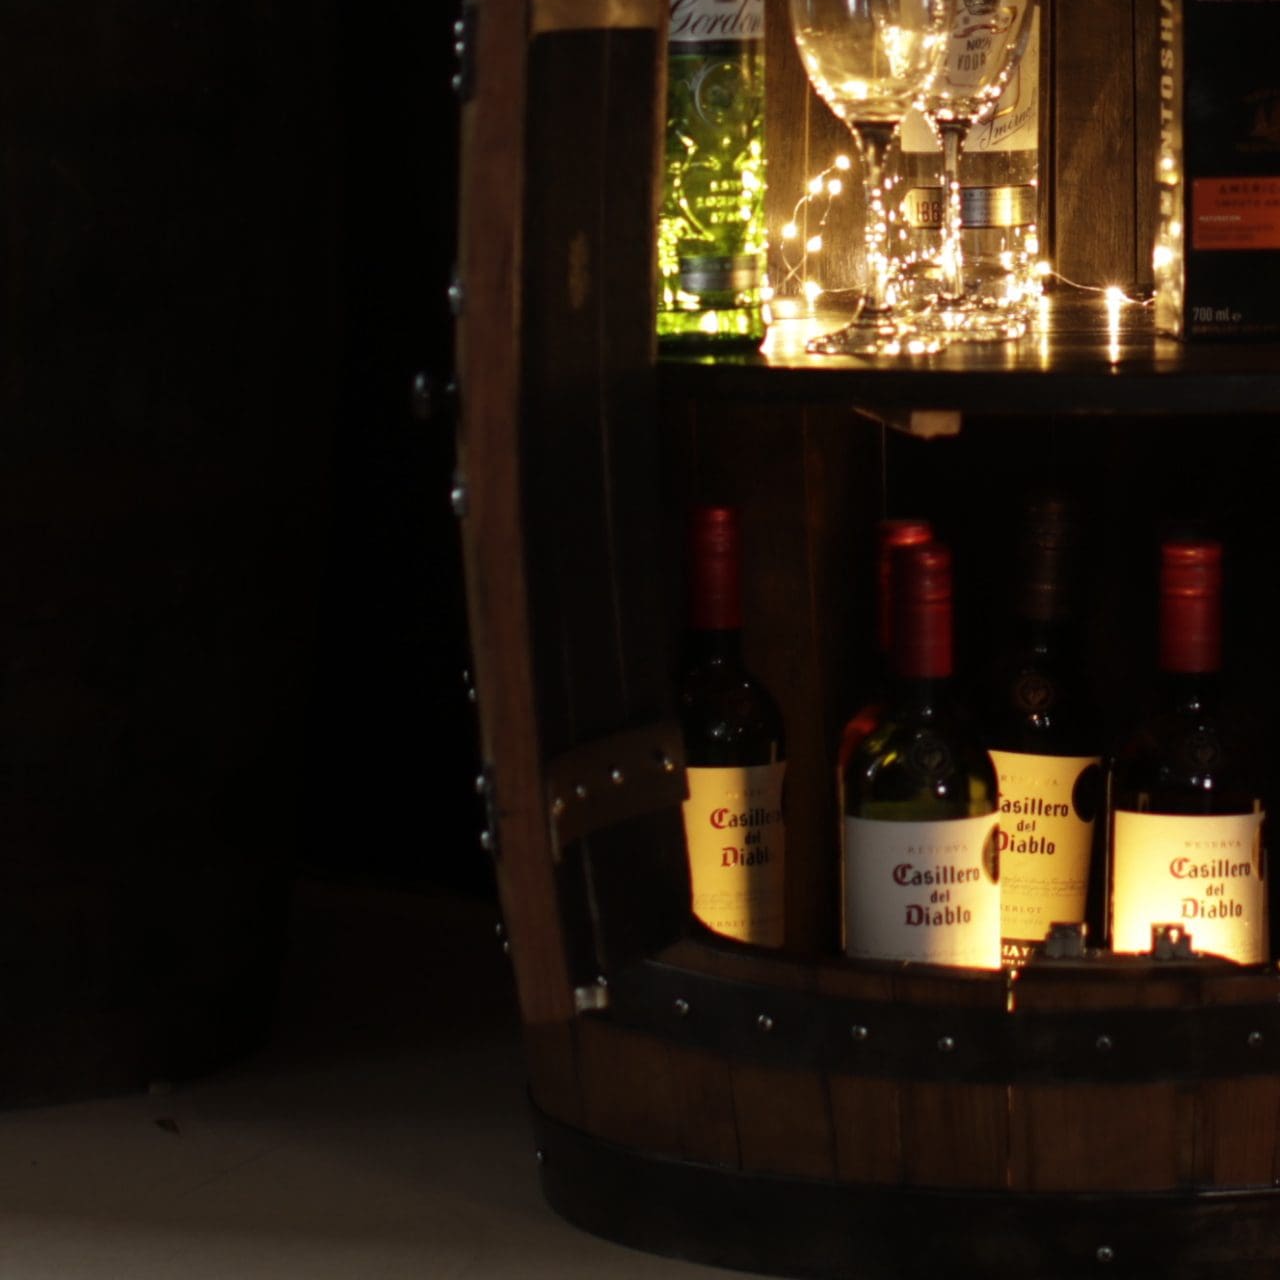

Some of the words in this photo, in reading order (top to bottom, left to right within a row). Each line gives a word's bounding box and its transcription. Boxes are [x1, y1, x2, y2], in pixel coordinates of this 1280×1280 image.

[1193, 306, 1212, 322] 700
[999, 792, 1069, 817] asillero
[1016, 820, 1036, 832] del
[893, 863, 980, 886] Casillero
[1169, 857, 1252, 879] Casillero
[930, 889, 950, 903] del
[1206, 883, 1225, 896] del
[905, 904, 971, 926] Diablo
[1182, 898, 1243, 918] Diablo
